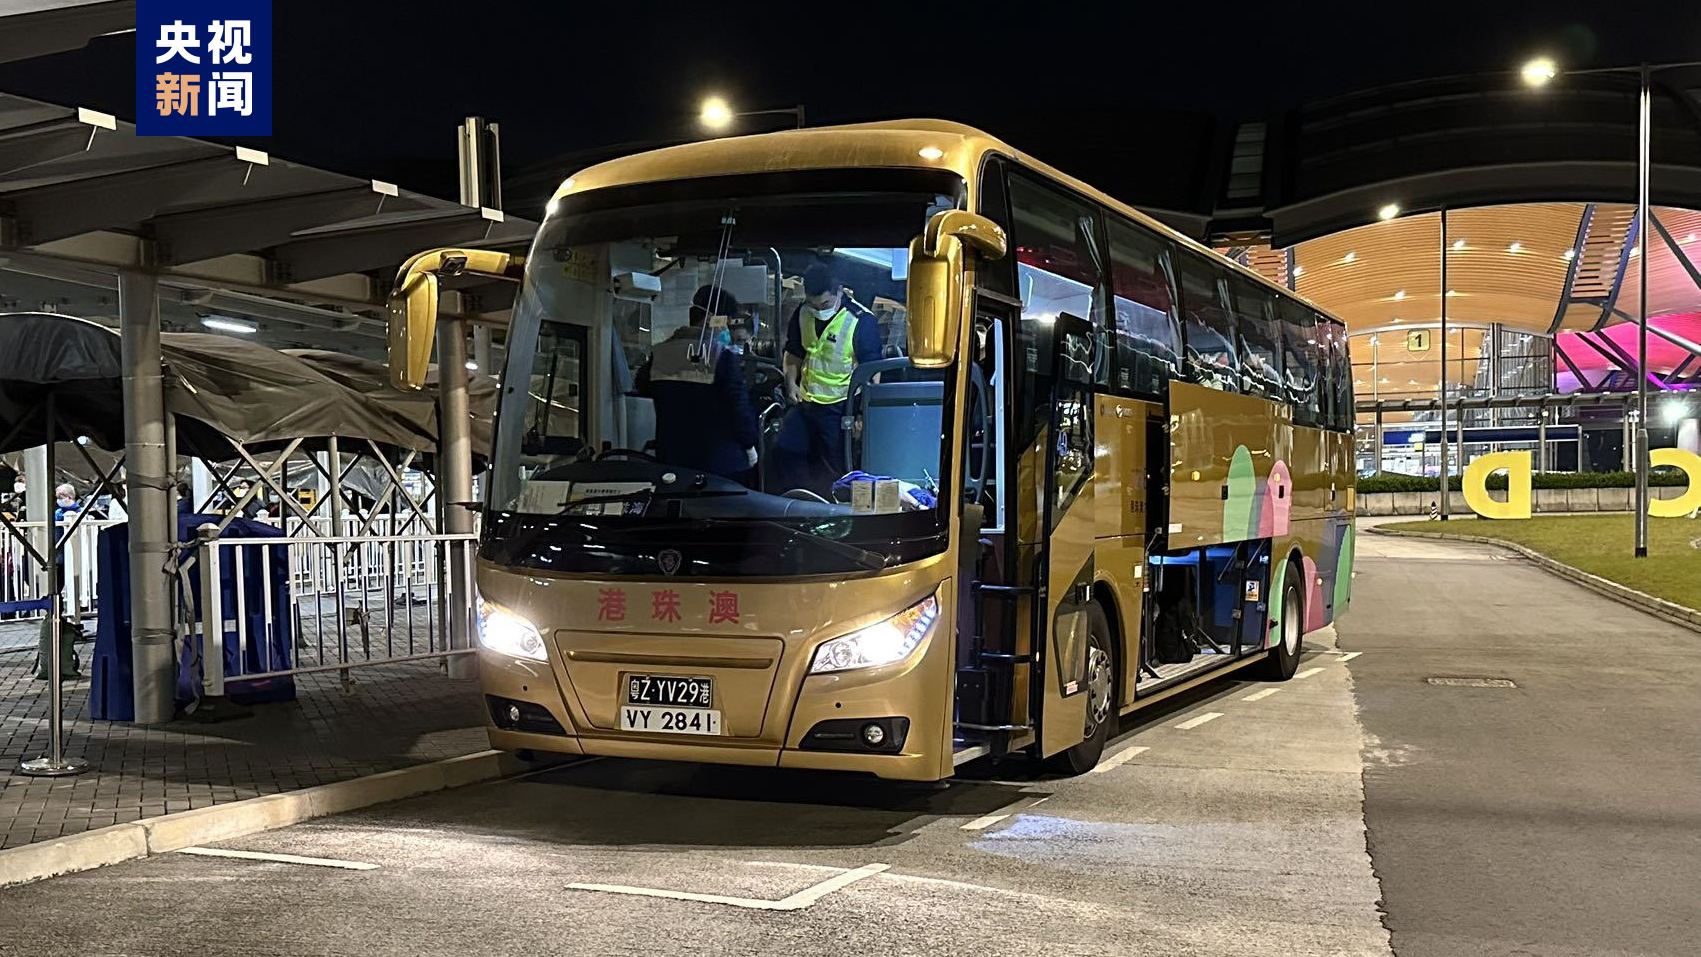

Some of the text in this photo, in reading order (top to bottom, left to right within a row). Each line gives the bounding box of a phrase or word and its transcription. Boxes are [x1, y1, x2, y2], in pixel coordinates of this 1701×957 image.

[1415, 334, 1422, 348] 1
[626, 709, 711, 732] VY 2841
